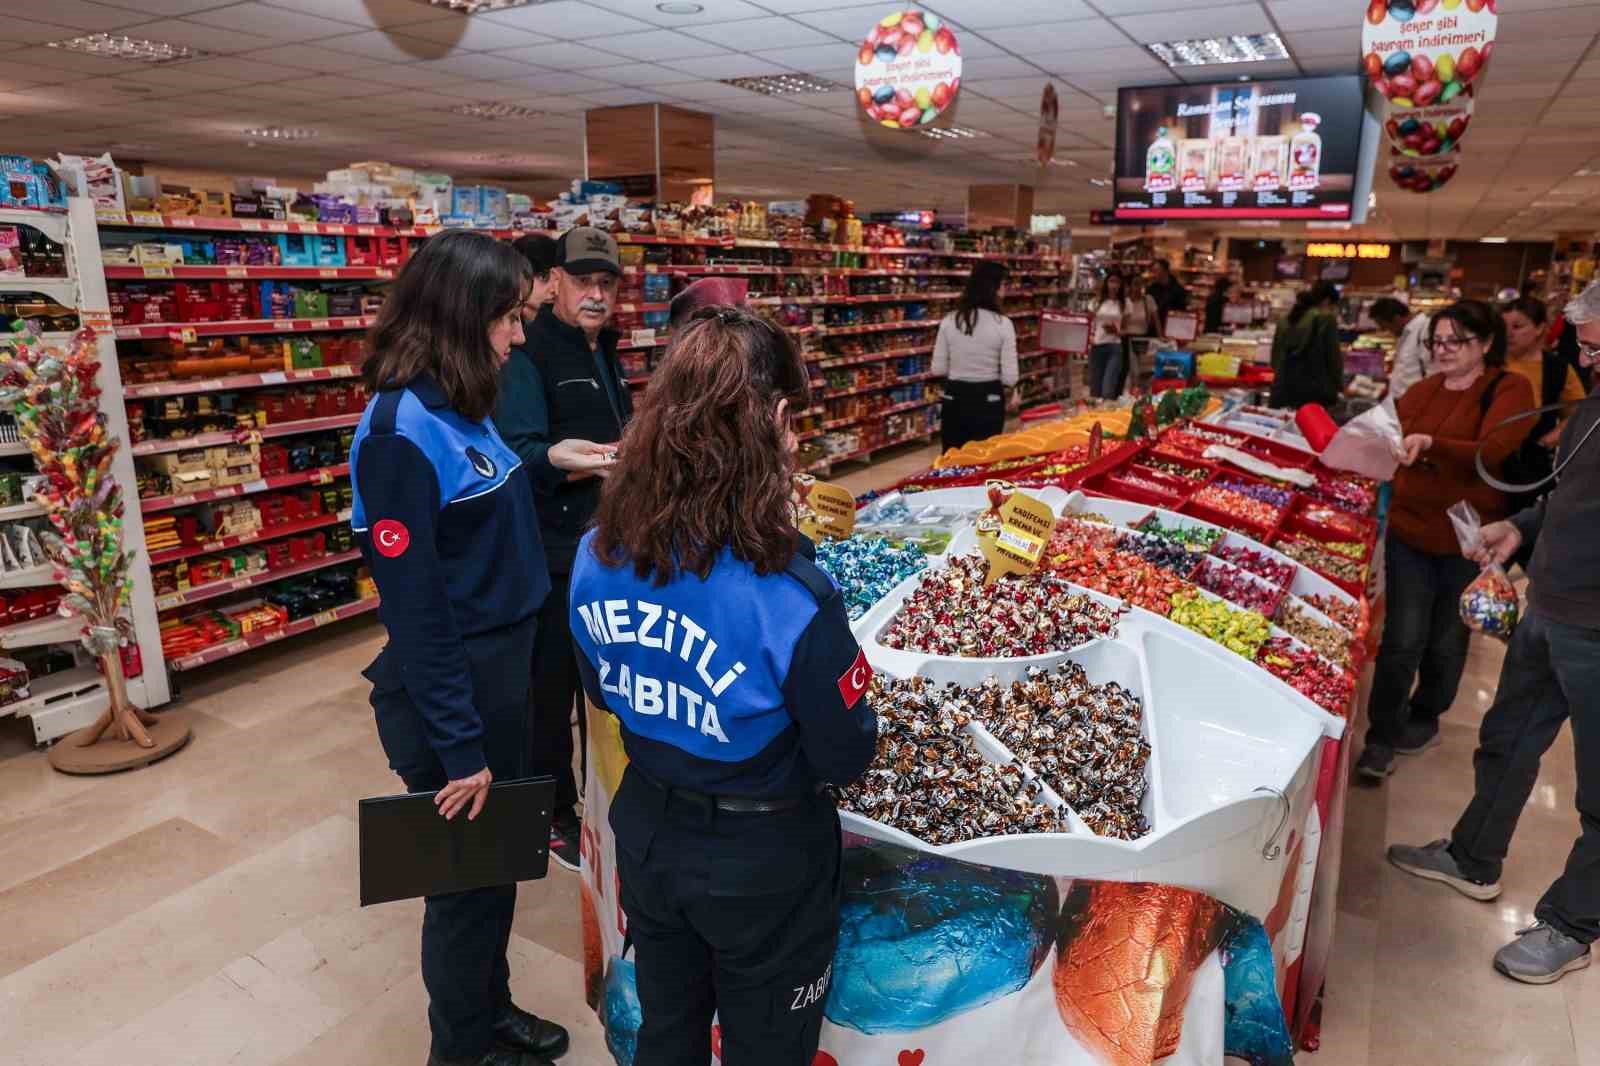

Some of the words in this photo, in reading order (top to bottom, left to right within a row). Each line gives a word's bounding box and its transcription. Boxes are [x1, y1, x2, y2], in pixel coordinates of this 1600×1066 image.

[1437, 15, 1458, 31] gibi
[1371, 38, 1415, 52] bayram
[1417, 29, 1486, 48] indirimleri
[598, 651, 731, 744] ZABITA
